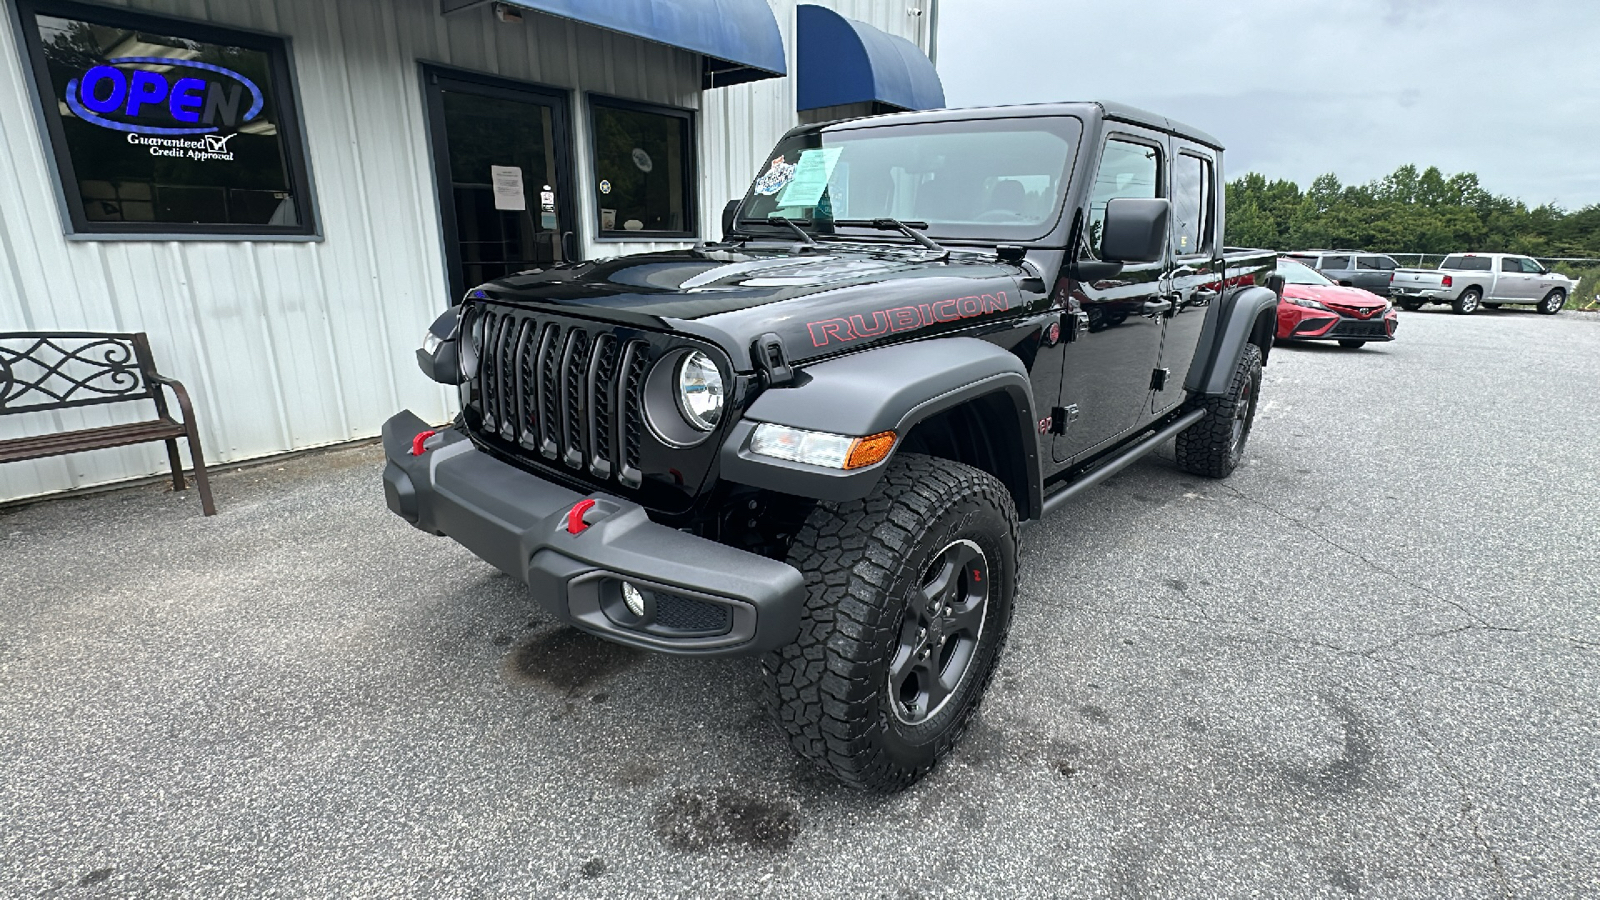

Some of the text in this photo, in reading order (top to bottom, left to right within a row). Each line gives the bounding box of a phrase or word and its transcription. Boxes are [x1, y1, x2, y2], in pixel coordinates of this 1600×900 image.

[81, 65, 242, 126] OPEN
[127, 133, 206, 149] Guaranteed
[149, 146, 234, 161] Credit Approval
[807, 291, 1009, 347] RUBICON
